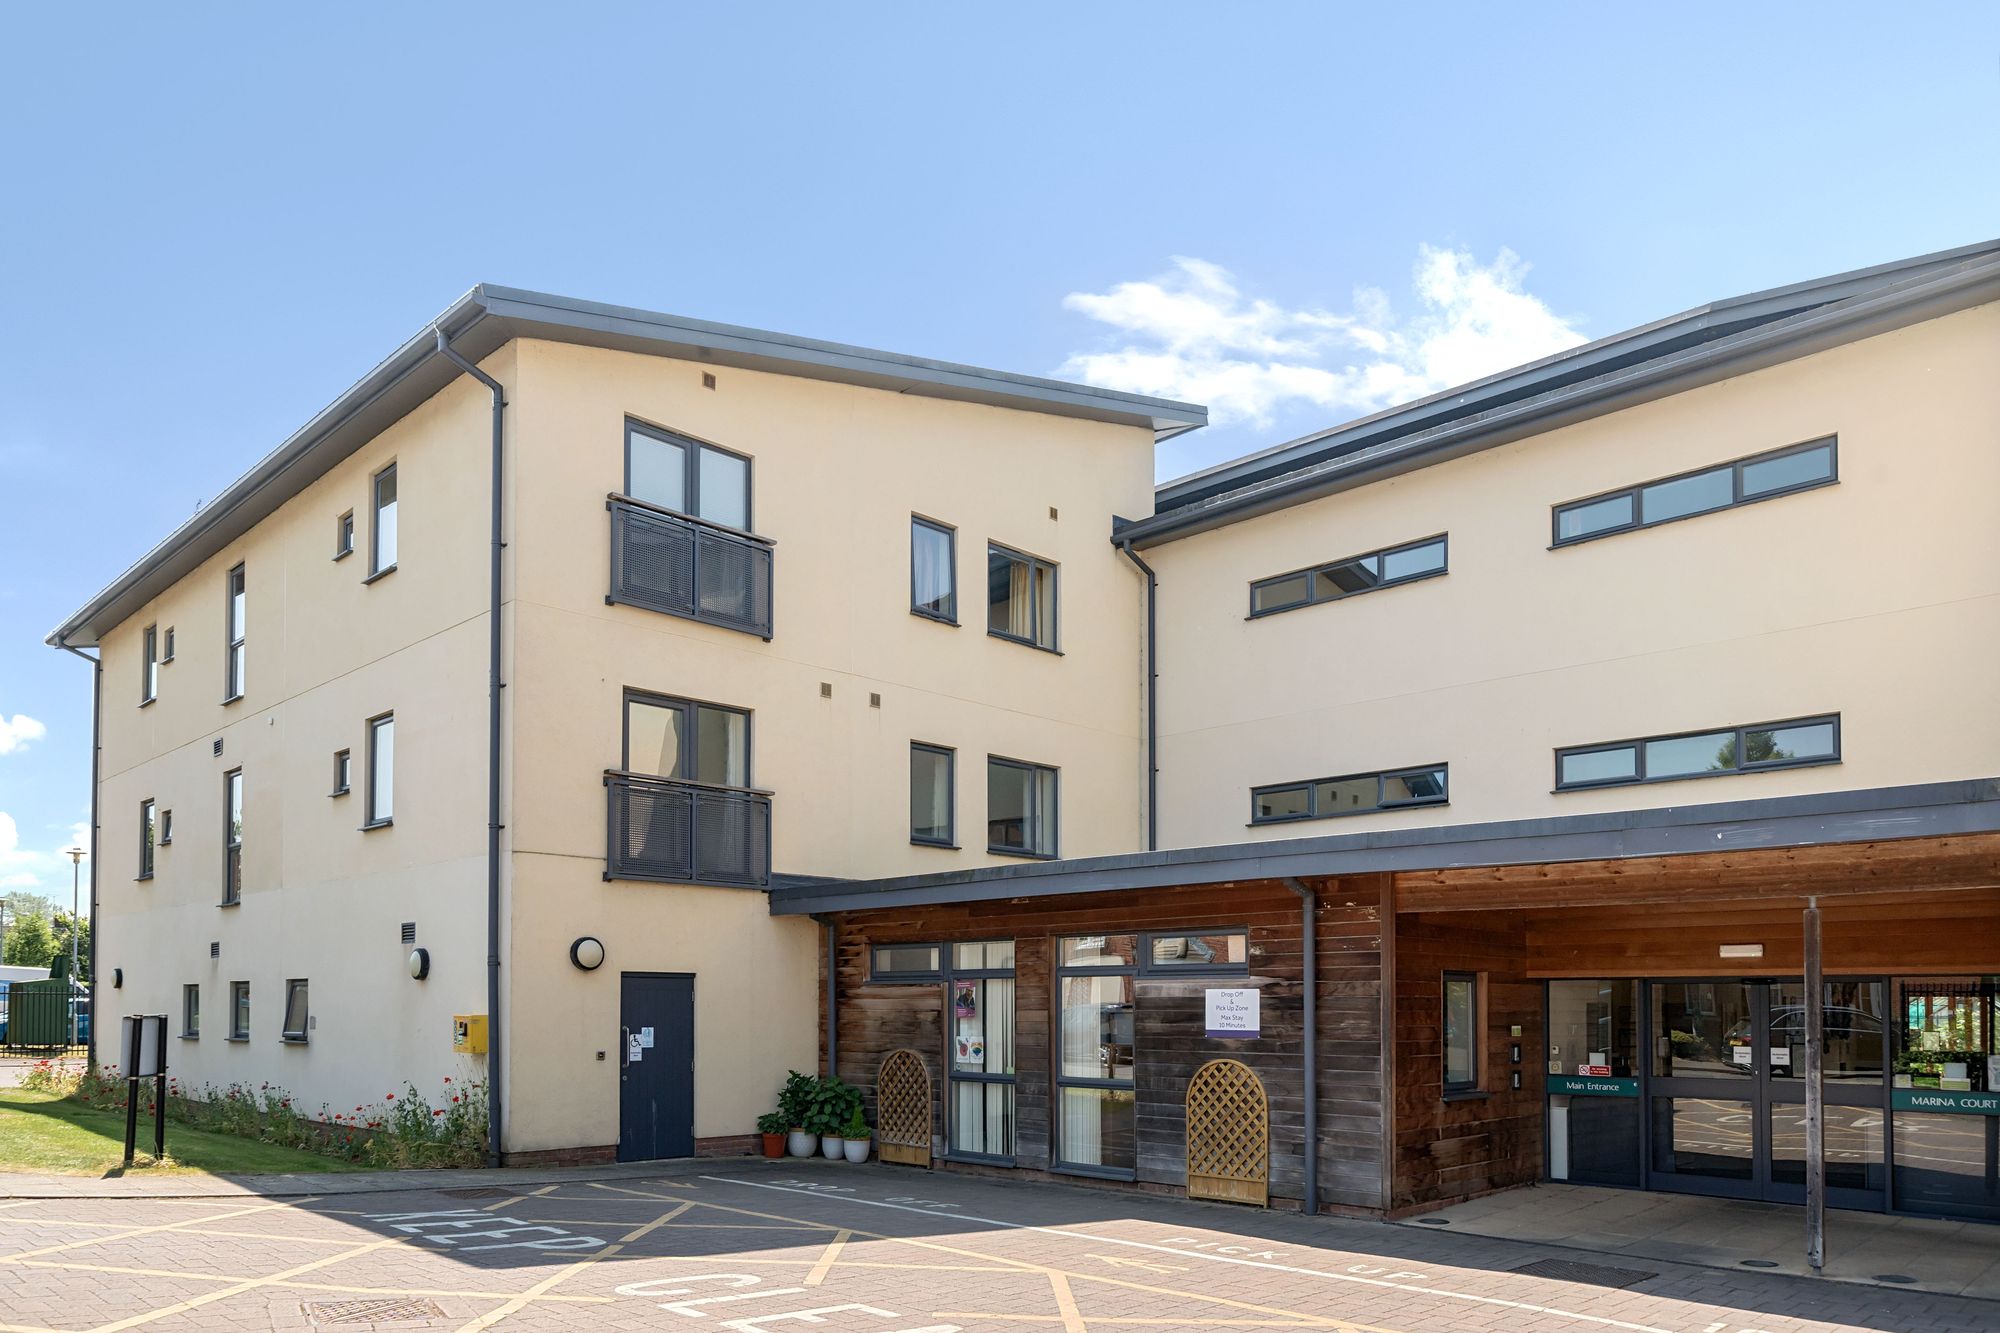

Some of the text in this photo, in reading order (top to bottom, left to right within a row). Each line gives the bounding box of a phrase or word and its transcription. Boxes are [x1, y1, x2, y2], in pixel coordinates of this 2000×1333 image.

[1566, 1081, 1620, 1091] Main Entrance
[1911, 1096, 1998, 1109] MARINA COURT
[768, 1179, 962, 1208] DROP OFF
[360, 1209, 607, 1251] KEEP
[1158, 1236, 1429, 1279] PICK UP
